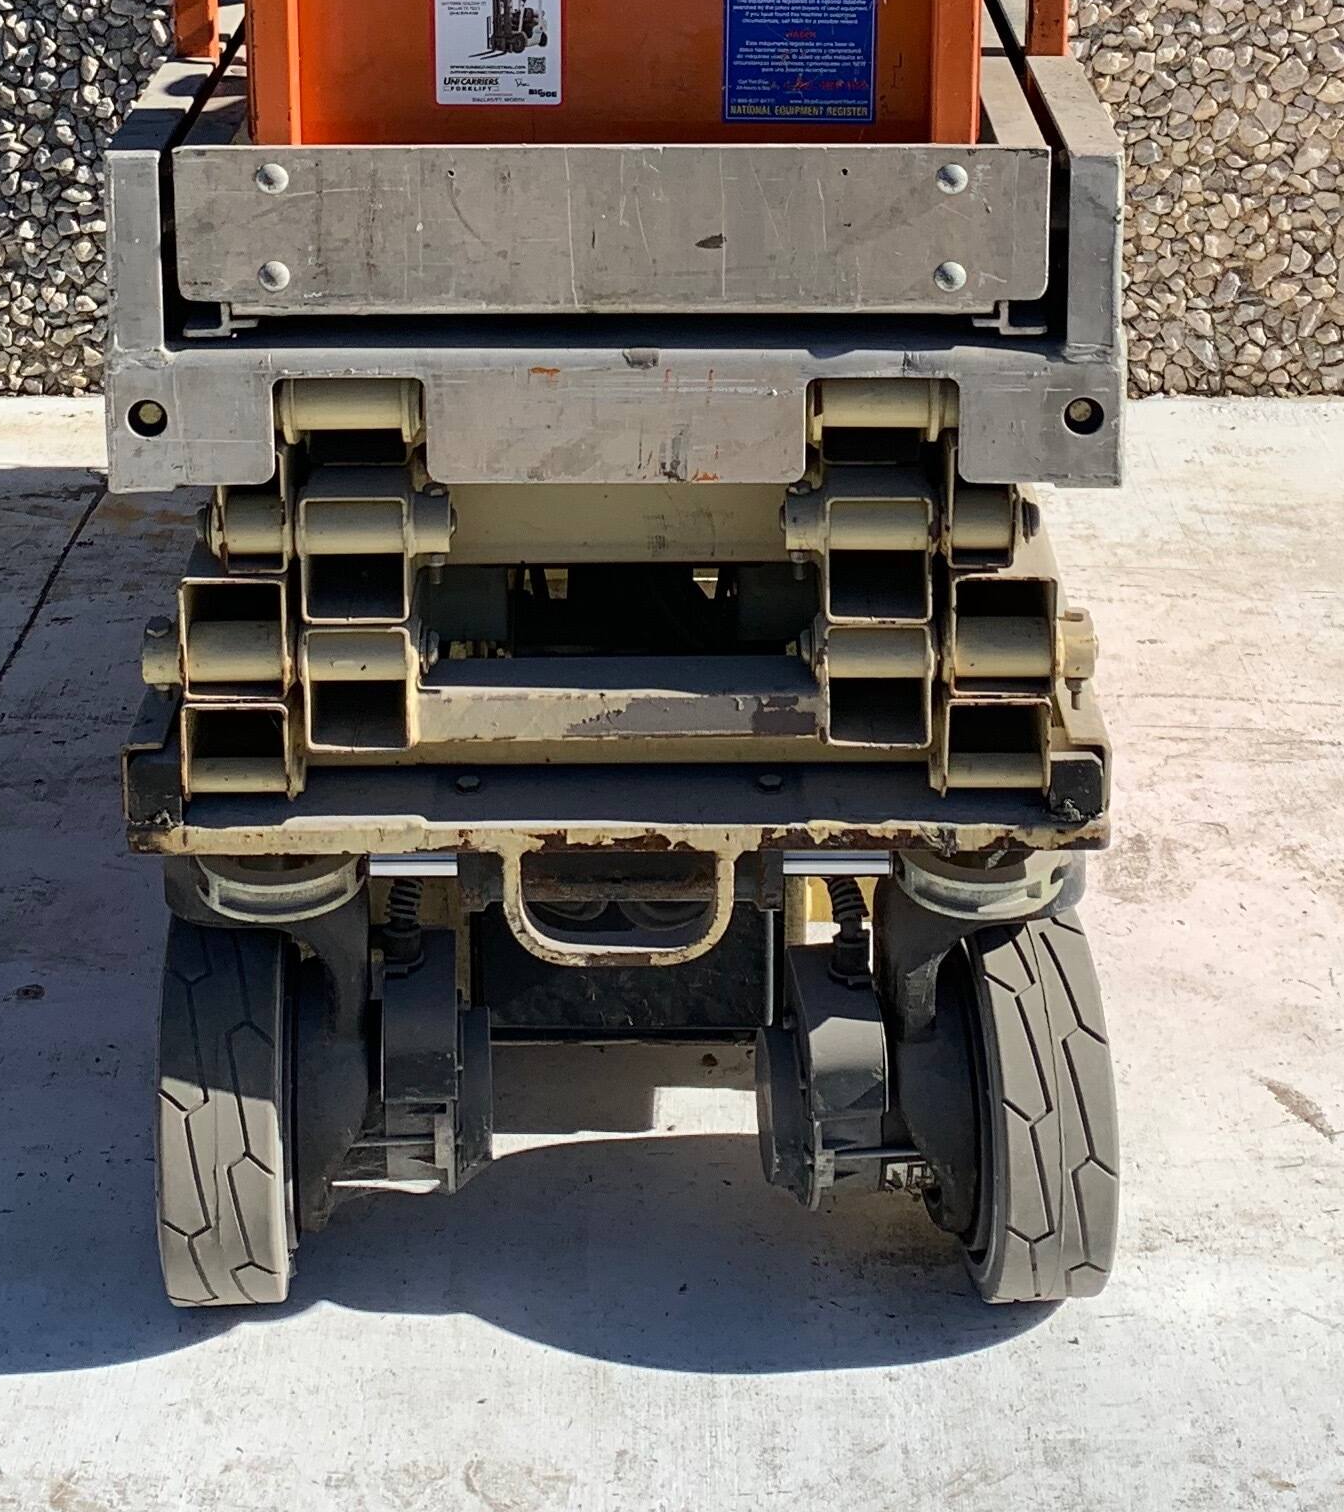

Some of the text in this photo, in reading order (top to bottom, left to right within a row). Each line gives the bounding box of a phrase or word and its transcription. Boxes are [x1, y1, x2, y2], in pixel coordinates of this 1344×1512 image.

[730, 105, 868, 116] NATIONAL EQUIPMENT REGISTER
